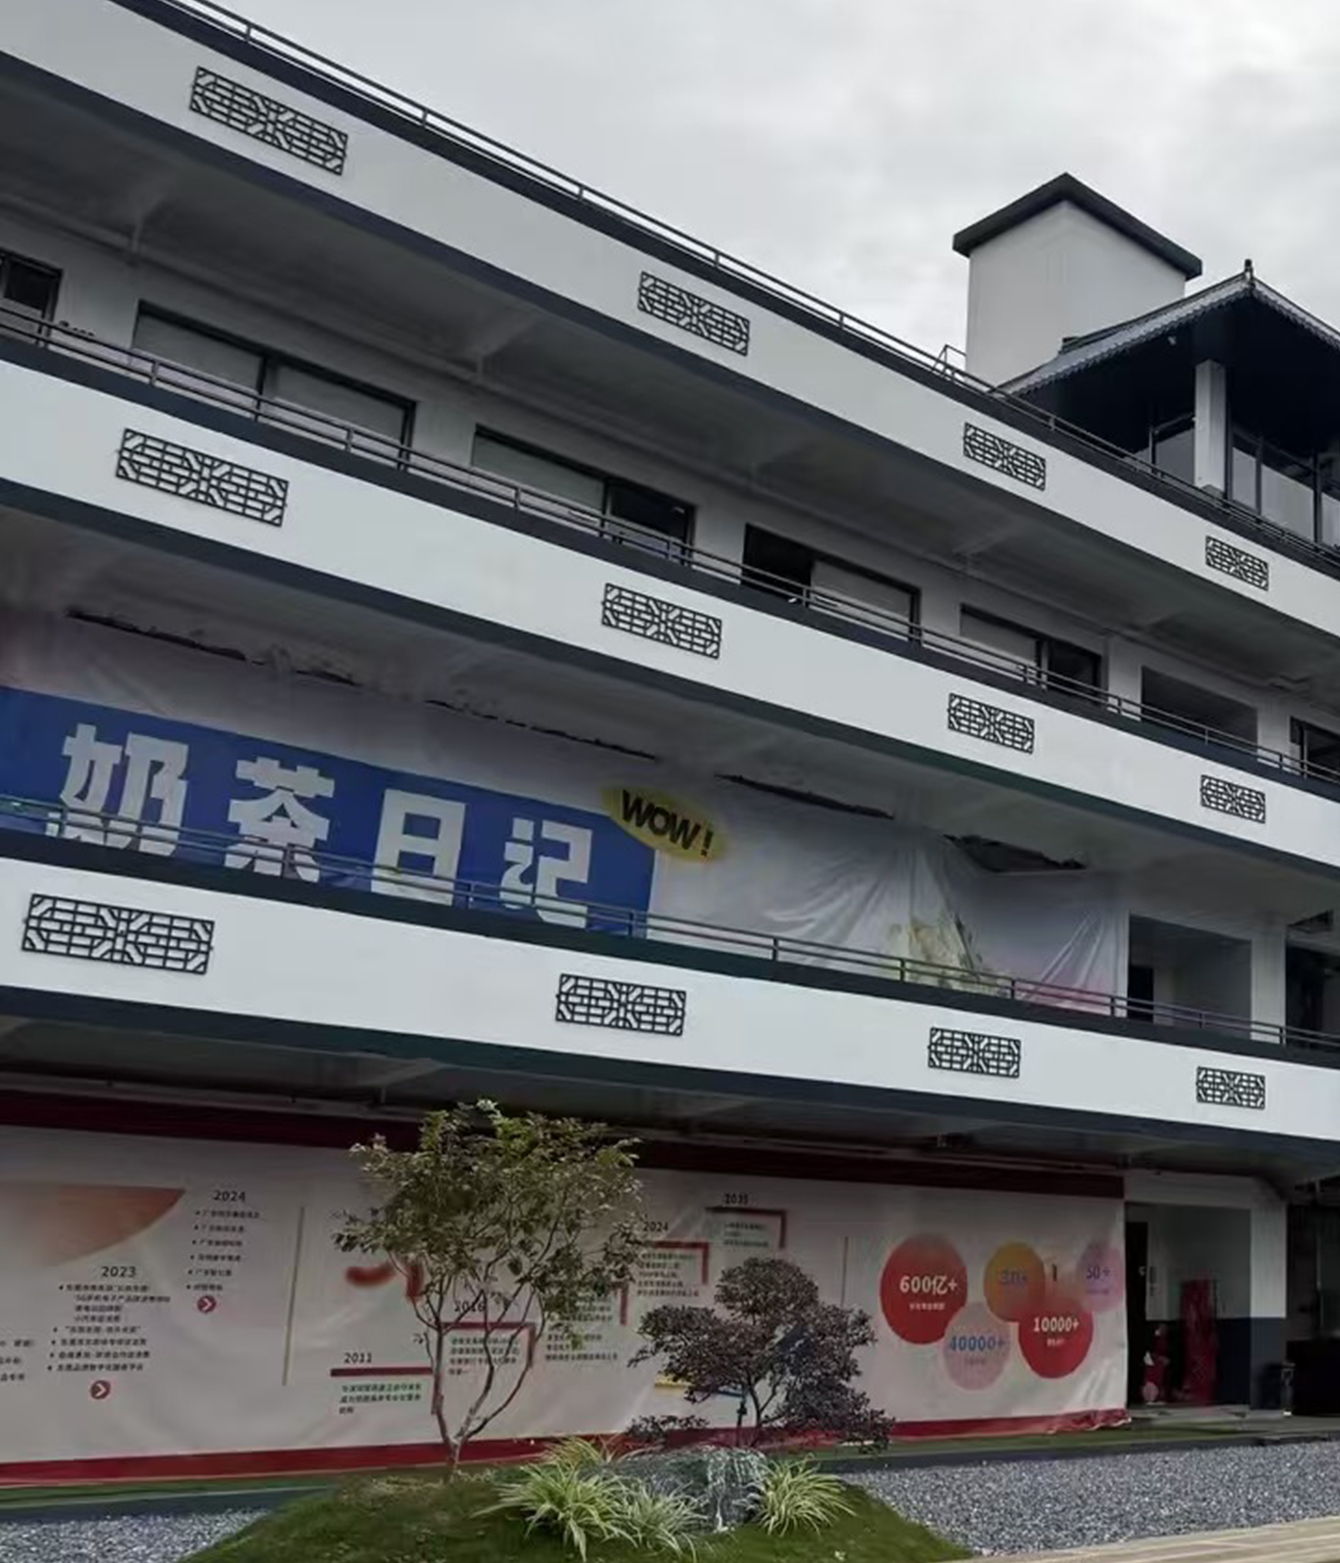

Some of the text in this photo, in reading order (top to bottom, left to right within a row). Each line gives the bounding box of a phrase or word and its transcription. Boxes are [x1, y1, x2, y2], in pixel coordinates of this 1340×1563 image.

[46, 723, 593, 929] 奶茶日记
[622, 789, 714, 857] WOW!
[213, 1189, 246, 1202] 2024
[101, 1265, 137, 1278] 2023
[1033, 1316, 1079, 1333] 10000+
[951, 1336, 1005, 1351] 40000+
[343, 1352, 372, 1364] 2011
